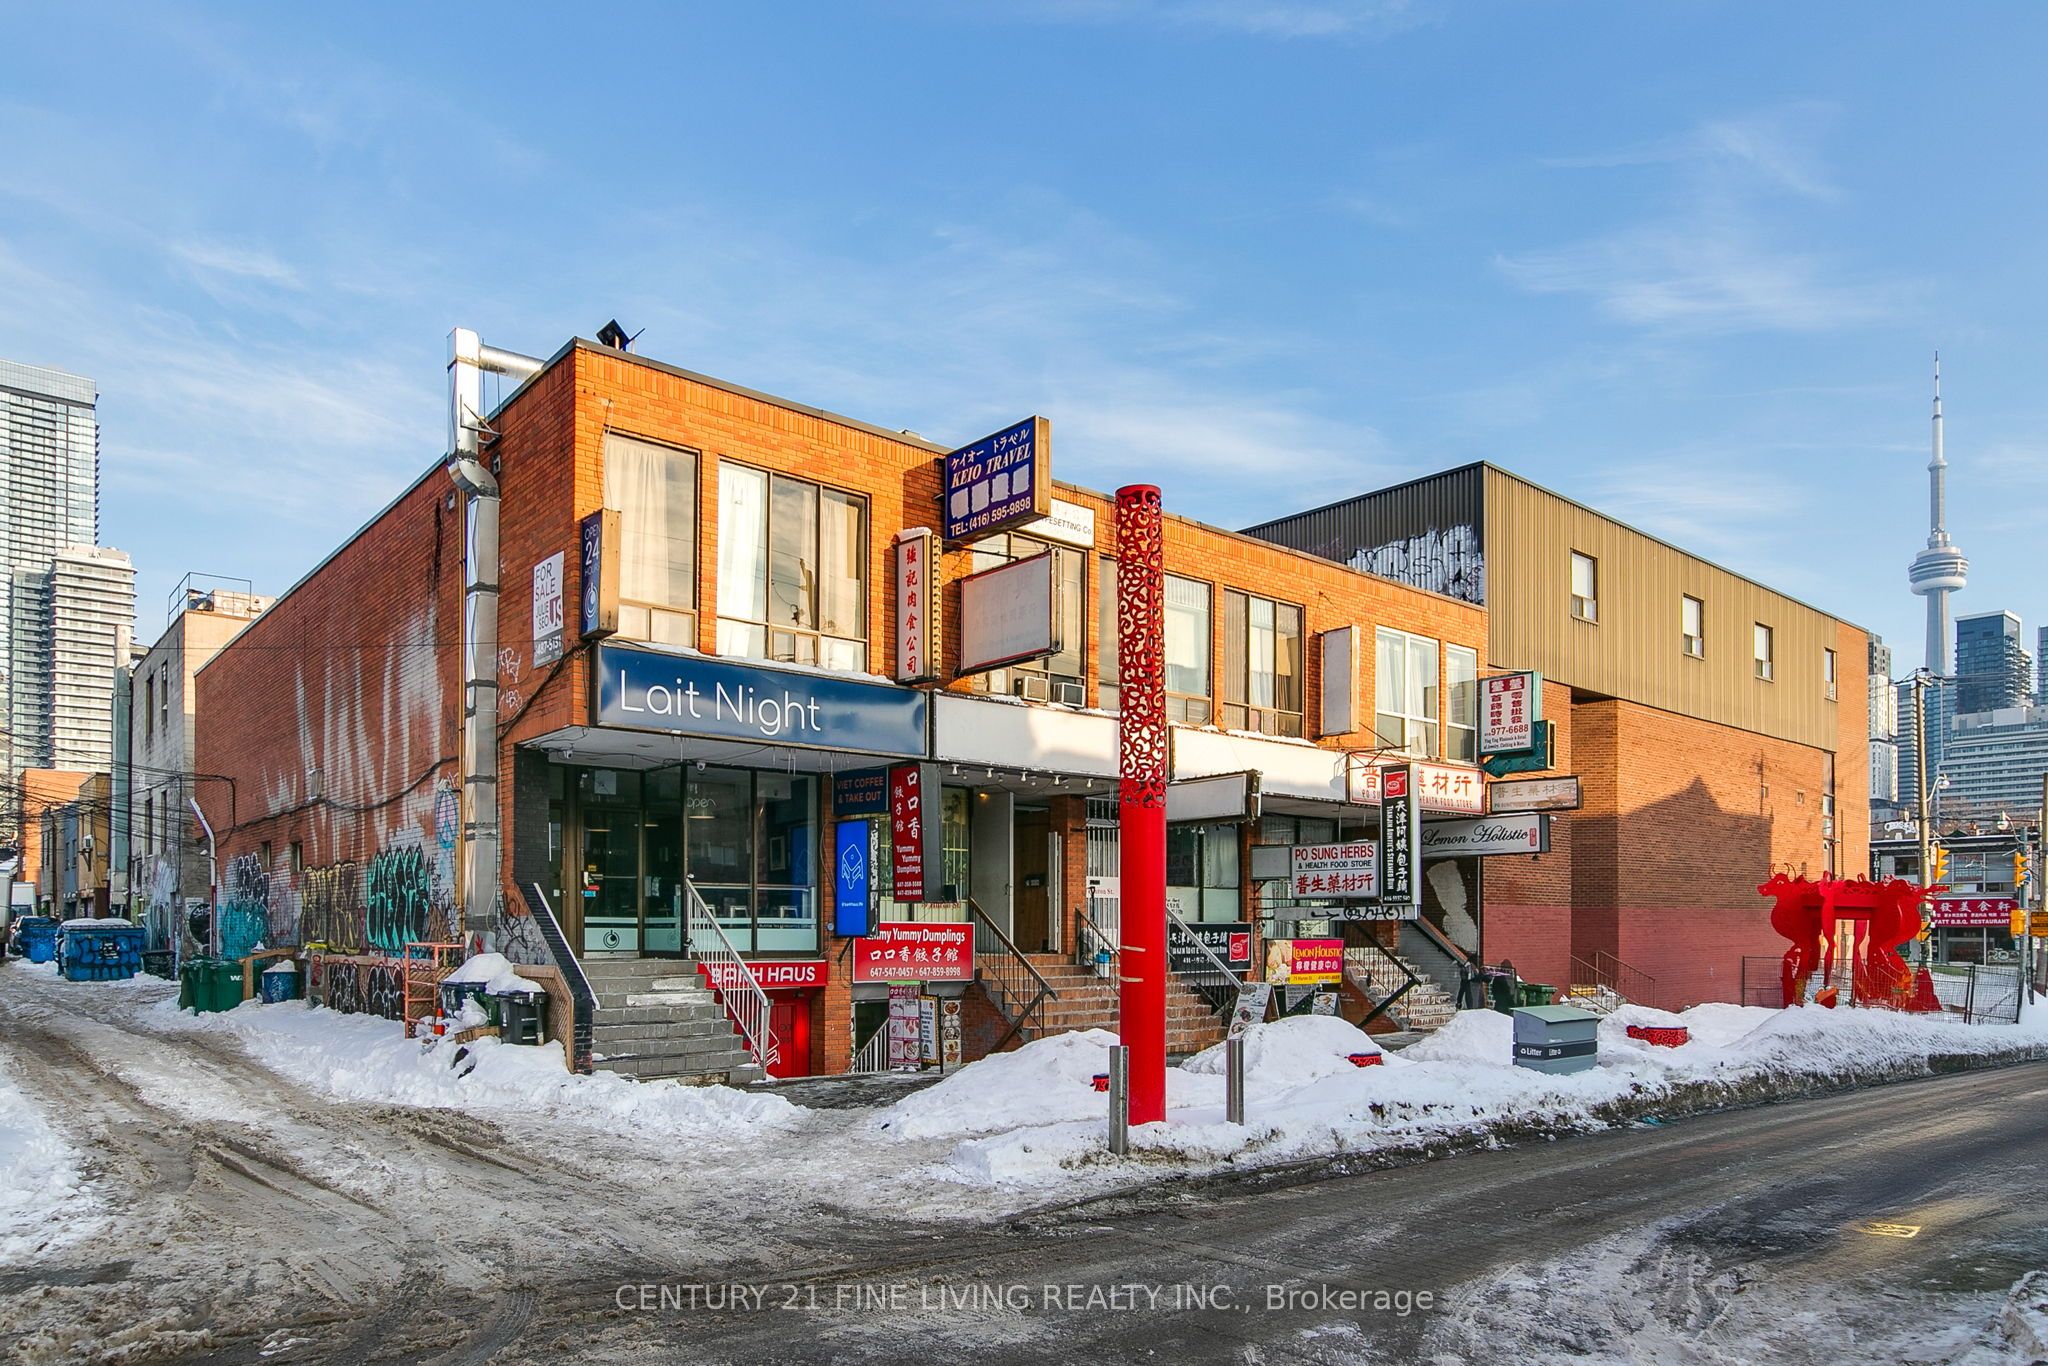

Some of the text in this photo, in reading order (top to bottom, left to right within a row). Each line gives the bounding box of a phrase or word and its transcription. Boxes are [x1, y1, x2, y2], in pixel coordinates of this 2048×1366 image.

[951, 428, 1030, 471] ケイオー トラベル
[951, 442, 1032, 489] KEIO TRAVEL
[950, 497, 1031, 537] TEL: (416) 595-9898
[1041, 516, 1081, 532] PESETTING
[584, 524, 601, 541] OPEN
[585, 537, 600, 566] 24
[535, 562, 552, 582] FOR
[535, 577, 556, 602] SALE
[535, 599, 549, 619] JULIE
[538, 615, 549, 630] SEO
[620, 669, 821, 736] Lait Night
[1491, 724, 1529, 736] 977-6688
[837, 776, 884, 790] VIET COFFEE
[838, 791, 882, 804] & TAKE OUT
[1440, 797, 1454, 807] FOOD
[1455, 799, 1473, 809] STORE
[1386, 805, 1394, 828] TIANJIN
[1422, 828, 1468, 846] Lemon
[1471, 824, 1529, 844] Holistic
[896, 845, 915, 854] Yummy
[1295, 844, 1374, 861] PO SUNG HERBS
[902, 854, 921, 864] Yummy
[1305, 861, 1328, 869] HEALTH
[1330, 860, 1349, 868] FOOD
[1386, 853, 1394, 878] STEAMED
[896, 865, 921, 875] Dumplings
[1296, 872, 1374, 895] 普生藥材行
[892, 928, 923, 943] Yummy
[923, 929, 965, 945] Dumplings
[1293, 945, 1342, 960] LEMON HOLISTIC
[711, 966, 816, 983] BANH HAUS
[870, 966, 961, 977] 647-547-0457 647-859-8998
[1526, 1047, 1542, 1056] Litter
